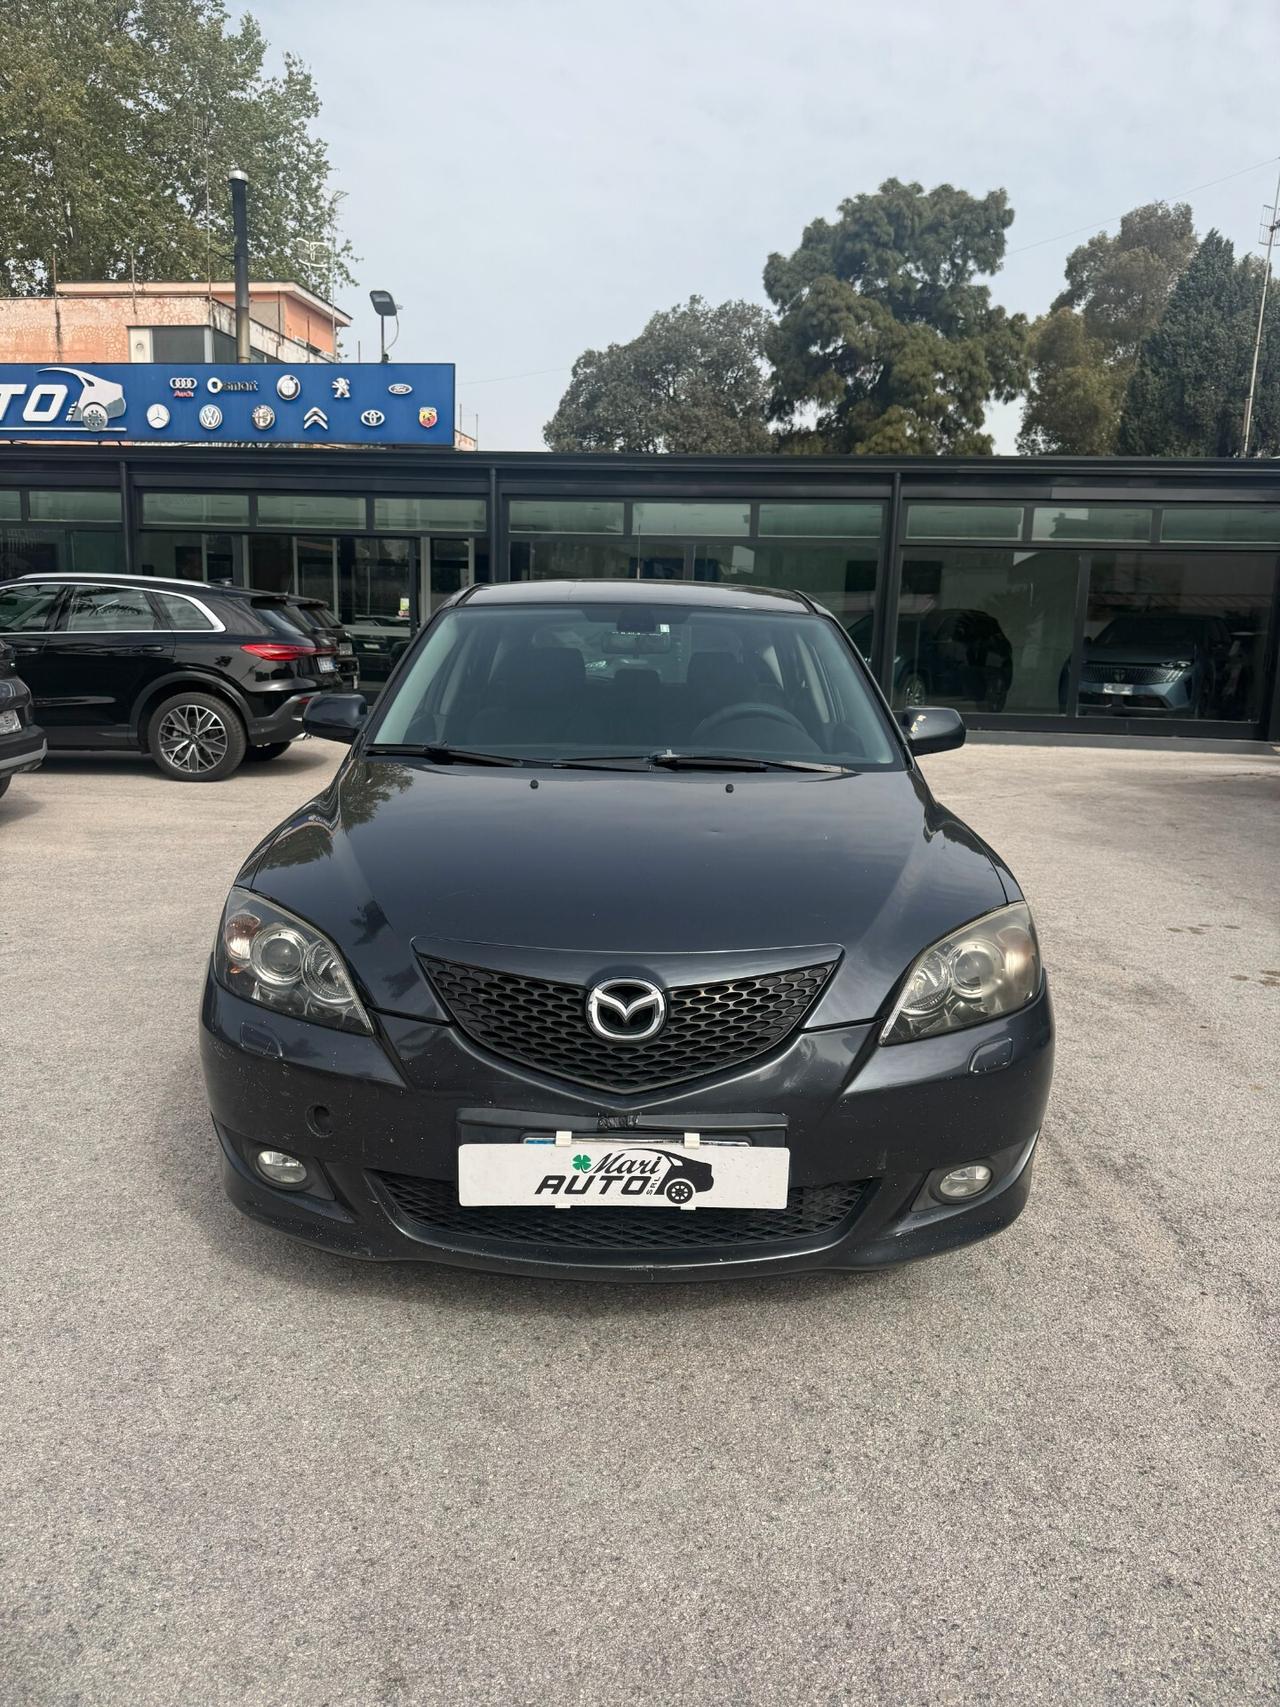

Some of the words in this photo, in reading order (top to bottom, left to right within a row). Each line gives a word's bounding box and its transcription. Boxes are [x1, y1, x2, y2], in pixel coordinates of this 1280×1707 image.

[590, 1152, 663, 1174] Mari
[535, 1175, 651, 1195] AUTO
[646, 1176, 661, 1195] SRL
